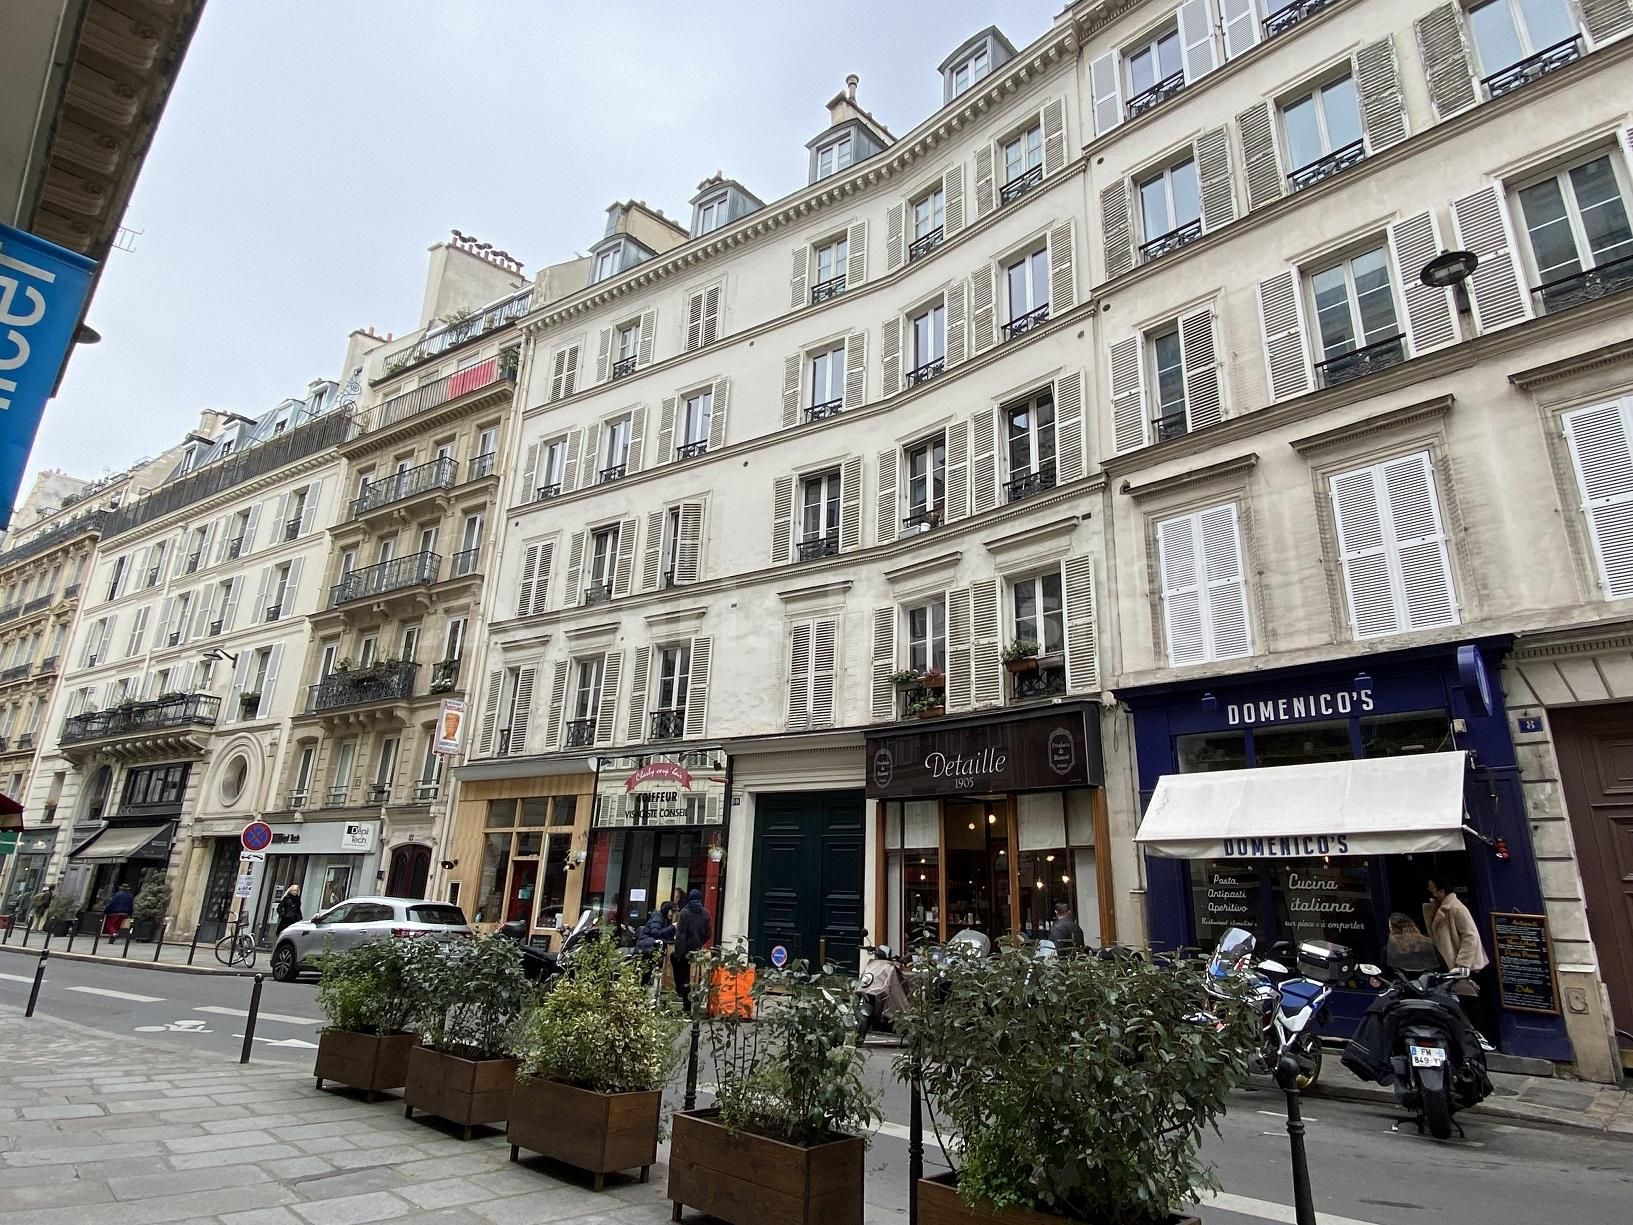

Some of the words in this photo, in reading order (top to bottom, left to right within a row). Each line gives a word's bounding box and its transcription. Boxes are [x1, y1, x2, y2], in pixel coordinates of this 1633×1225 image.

[1227, 689, 1375, 725] DOMENICO'S
[1526, 720, 1535, 730] 8
[924, 748, 1006, 778] Detaille
[955, 777, 974, 789] 1905
[637, 791, 678, 802] COIFFEUR
[659, 808, 688, 818] CONSEIL
[350, 836, 367, 844] Tech
[1223, 834, 1349, 857] DOMENICO'S
[1289, 873, 1338, 890] Cucina
[1207, 889, 1247, 900] Antipasti
[1208, 902, 1248, 914] Aperitivo
[1290, 897, 1355, 913] italiana
[1327, 920, 1365, 933] emporter
[1414, 1056, 1429, 1065] 849
